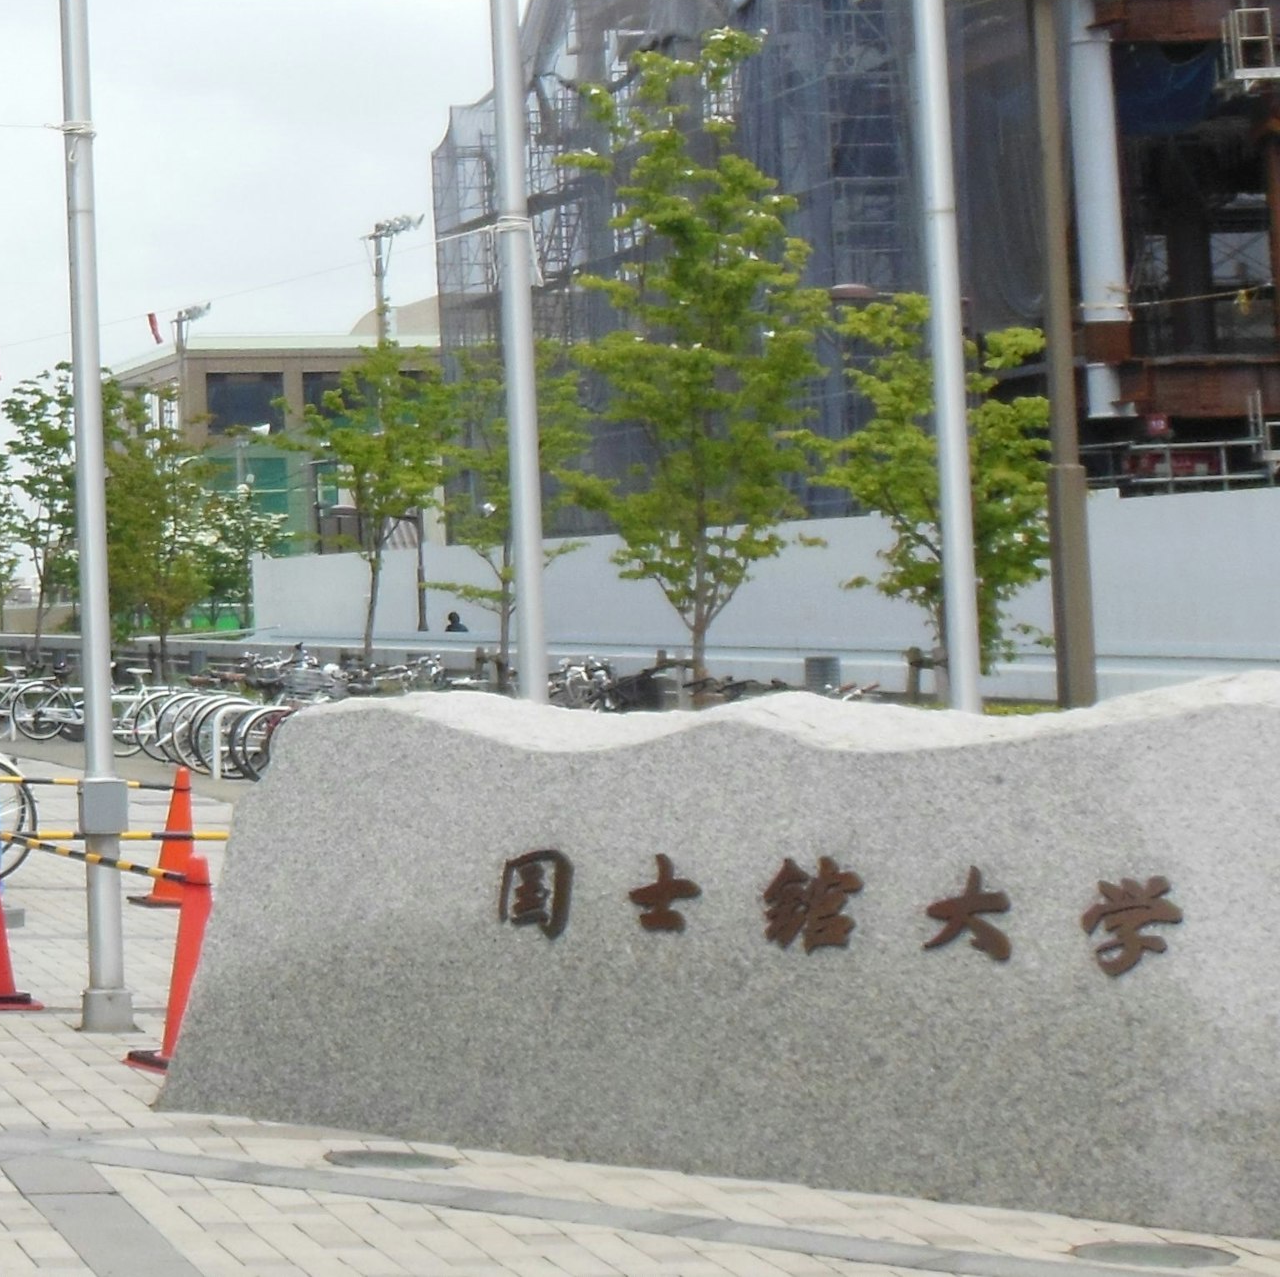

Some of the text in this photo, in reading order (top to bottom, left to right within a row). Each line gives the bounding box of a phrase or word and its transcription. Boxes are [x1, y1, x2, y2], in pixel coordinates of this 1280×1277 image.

[499, 849, 1183, 978] 国士舘大学
